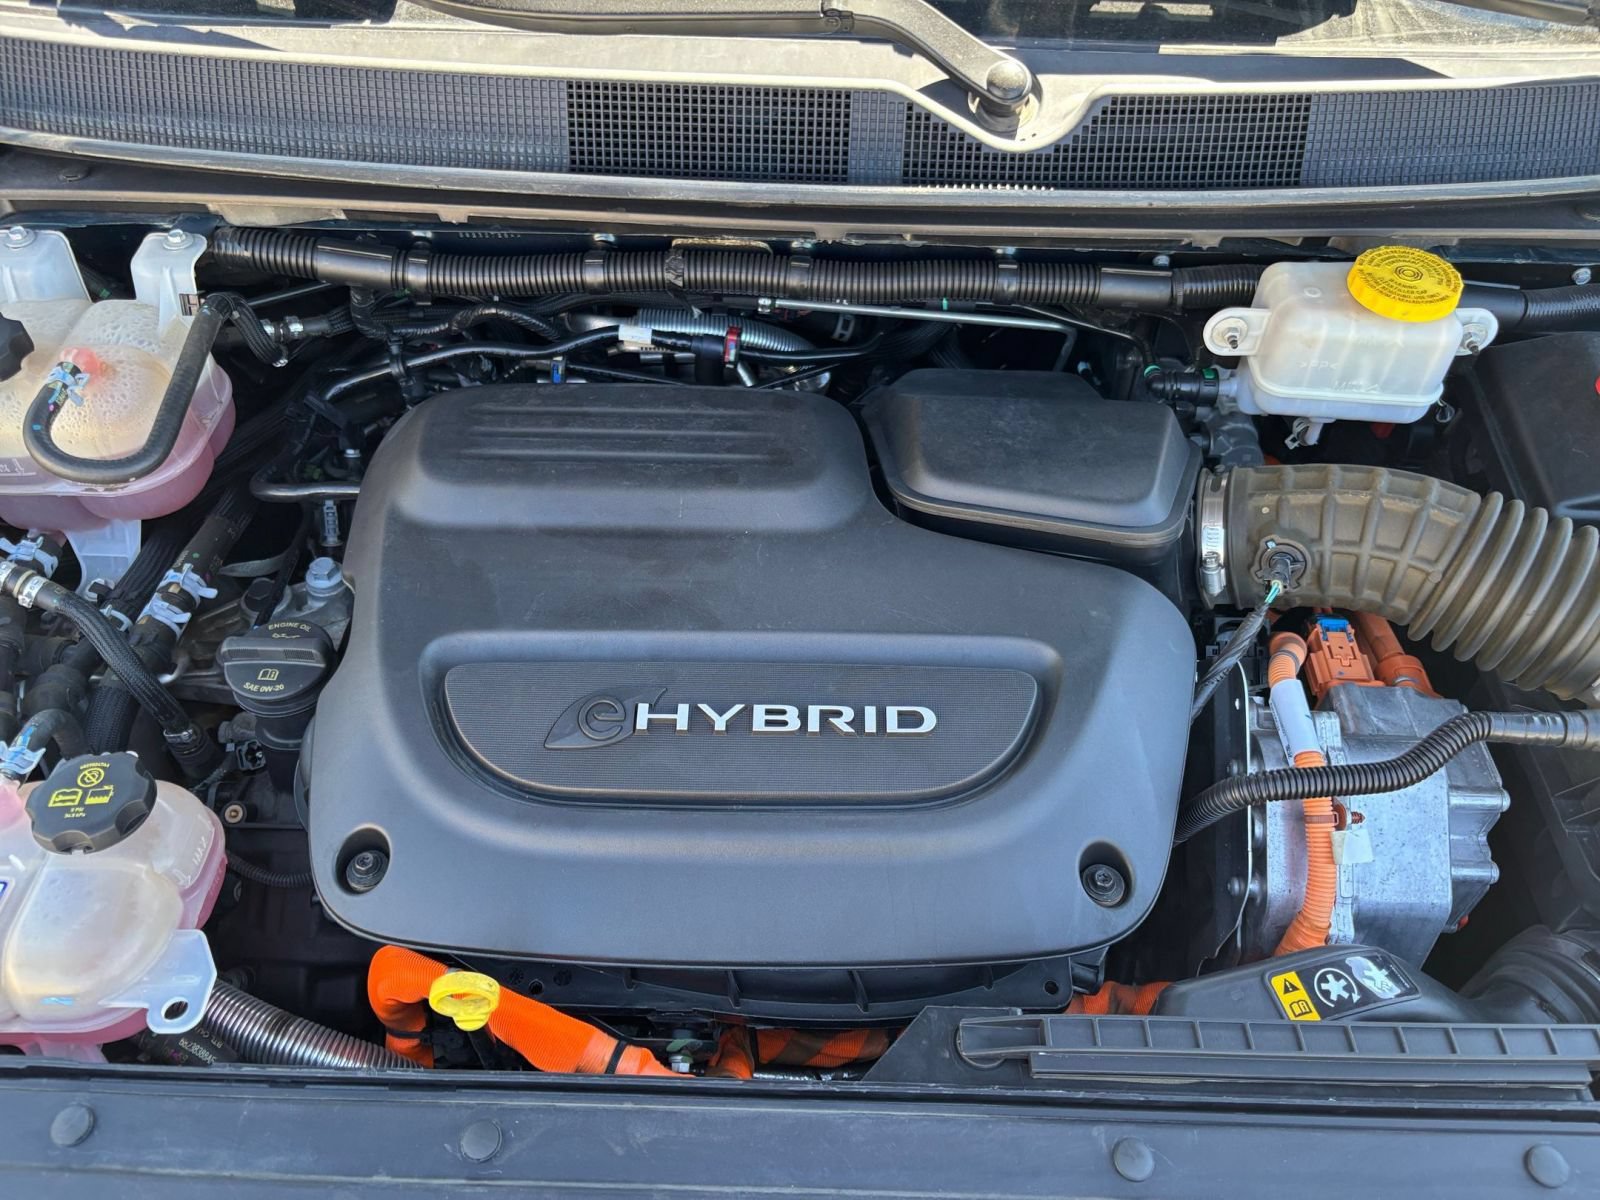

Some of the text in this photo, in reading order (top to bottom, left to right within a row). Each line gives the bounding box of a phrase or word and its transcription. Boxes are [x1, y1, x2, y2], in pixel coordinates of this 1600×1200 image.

[268, 622, 312, 632] ENGINE OIL
[243, 682, 285, 692] SAE 0W-20
